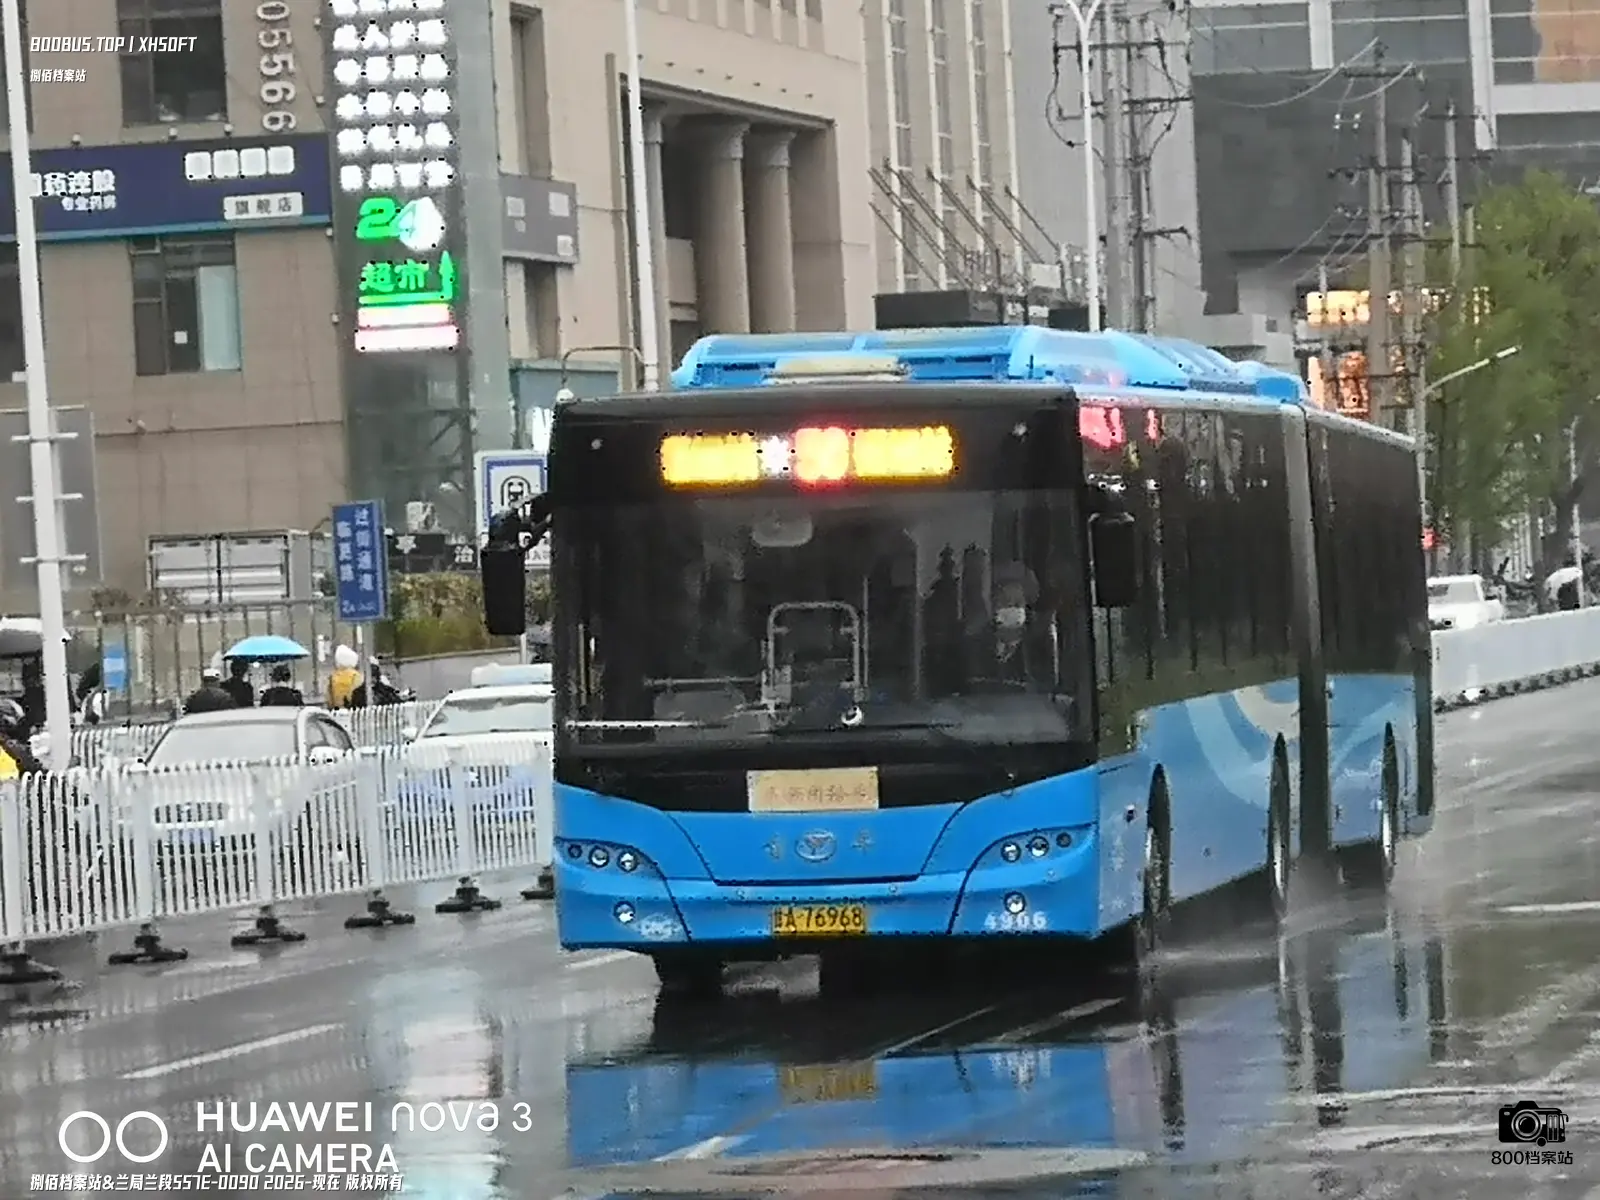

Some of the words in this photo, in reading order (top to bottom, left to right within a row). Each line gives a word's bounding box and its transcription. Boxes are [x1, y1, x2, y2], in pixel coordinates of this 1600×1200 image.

[29, 168, 116, 197] 药连锁
[359, 258, 430, 292] 超市
